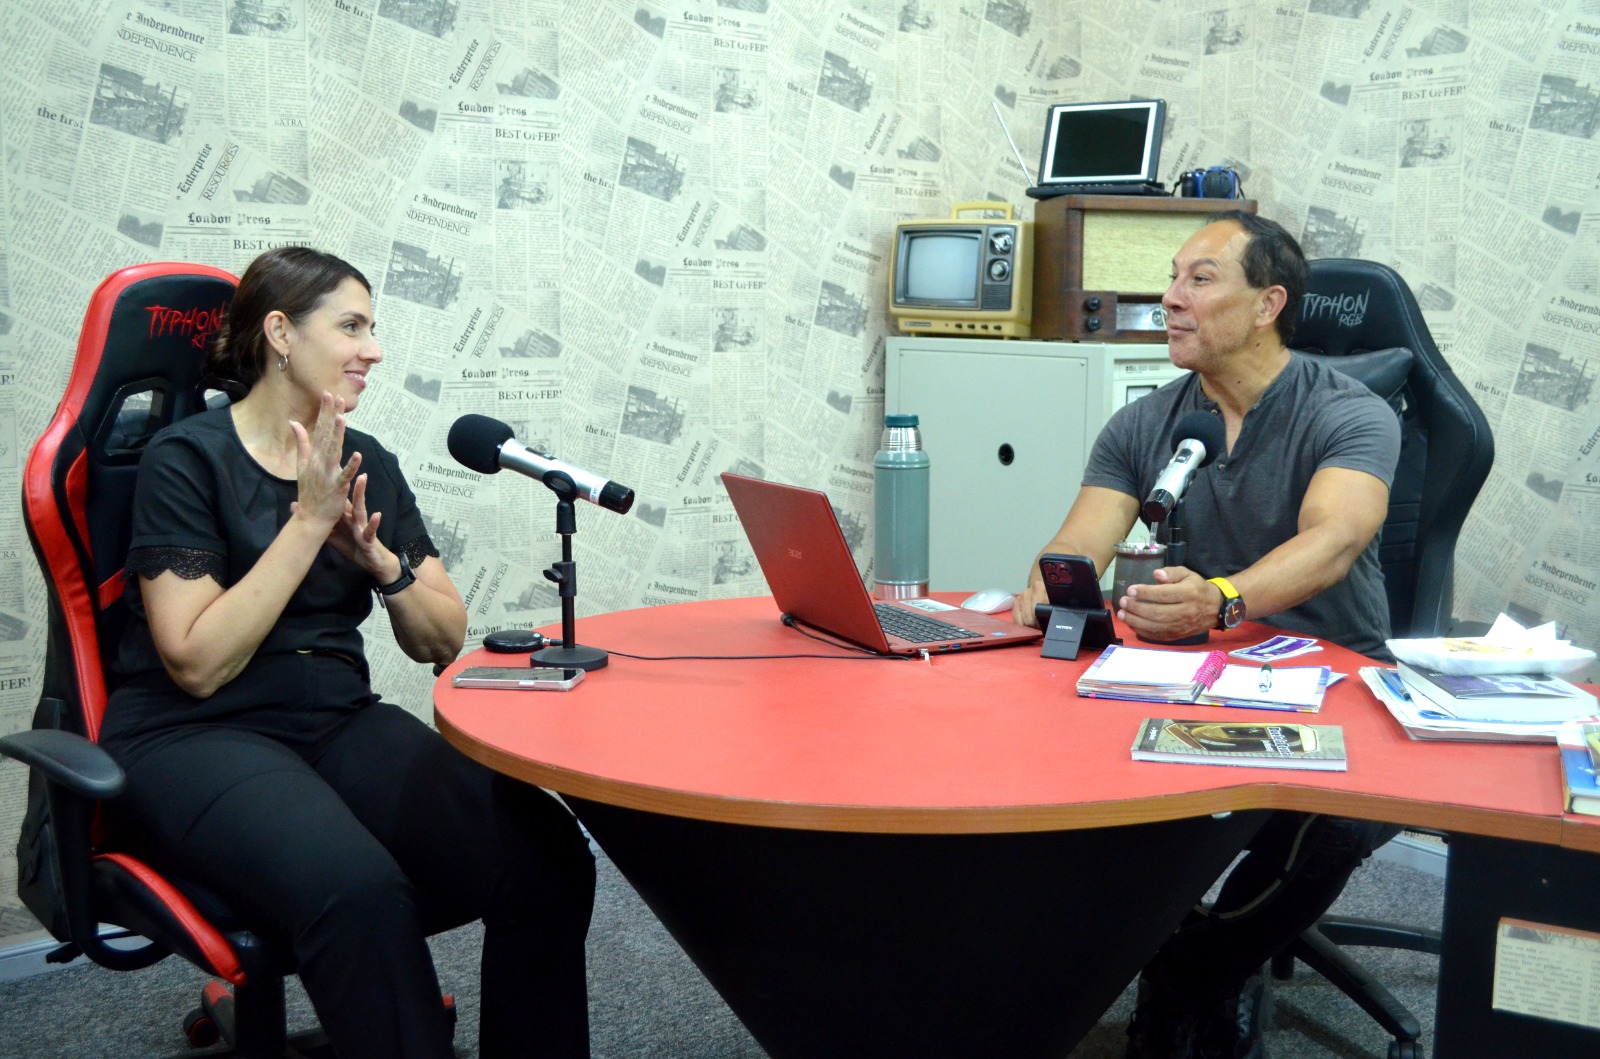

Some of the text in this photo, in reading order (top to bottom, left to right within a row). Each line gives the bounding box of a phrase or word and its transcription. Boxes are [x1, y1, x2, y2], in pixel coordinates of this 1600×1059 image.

[334, 0, 352, 12] the
[683, 11, 741, 28] London Press
[135, 11, 205, 45] Independence
[1364, 11, 1392, 57] Enterprise
[1381, 8, 1413, 60] RESOURCES
[714, 38, 737, 49] BEST
[1558, 40, 1600, 55] NDEPEND
[450, 39, 479, 84] Enterprise
[470, 40, 501, 91] RESOURCES
[1369, 66, 1434, 82] London Press
[787, 81, 798, 92] the
[1402, 89, 1427, 100] BEST
[37, 107, 57, 121] the
[458, 101, 527, 116] London Press
[652, 94, 698, 120] Independence
[495, 128, 521, 139] BEST
[1489, 120, 1504, 131] the
[180, 143, 213, 193] Enterprise
[202, 143, 240, 200] RESOURCES
[1334, 161, 1382, 180] Independence
[583, 172, 598, 184] the
[894, 187, 913, 197] BEST
[421, 193, 477, 220] Independence
[187, 213, 231, 226] London
[236, 213, 271, 226] Press
[677, 200, 701, 242] Enterprise
[694, 202, 719, 248] RESOURCES
[233, 239, 265, 250] BEST
[683, 257, 713, 268] London
[713, 280, 735, 289] BEST
[1302, 287, 1370, 321] TYPHON
[1559, 295, 1600, 316] Independ
[145, 301, 225, 339] TYPHON
[784, 315, 796, 325] the
[1338, 312, 1363, 328] RGB
[1541, 312, 1600, 336] NDEPENDENC
[453, 306, 482, 352] Enterprise
[474, 306, 504, 358] RESOURCES
[652, 342, 698, 363] Independence
[461, 368, 529, 380] London Press
[499, 390, 524, 400] BEST
[1475, 381, 1489, 393] the
[585, 425, 599, 435] the
[677, 440, 701, 482] Enterprise
[693, 439, 719, 486] RESOURCES
[427, 462, 482, 484] Independence
[683, 495, 712, 505] London
[712, 514, 734, 524] BEST
[1540, 560, 1596, 591] Independence
[465, 566, 487, 611] nterprise
[479, 562, 509, 615] RESOURCES
[654, 581, 698, 597] Independence
[506, 621, 533, 630] ress
[1, 677, 31, 691] FER!
